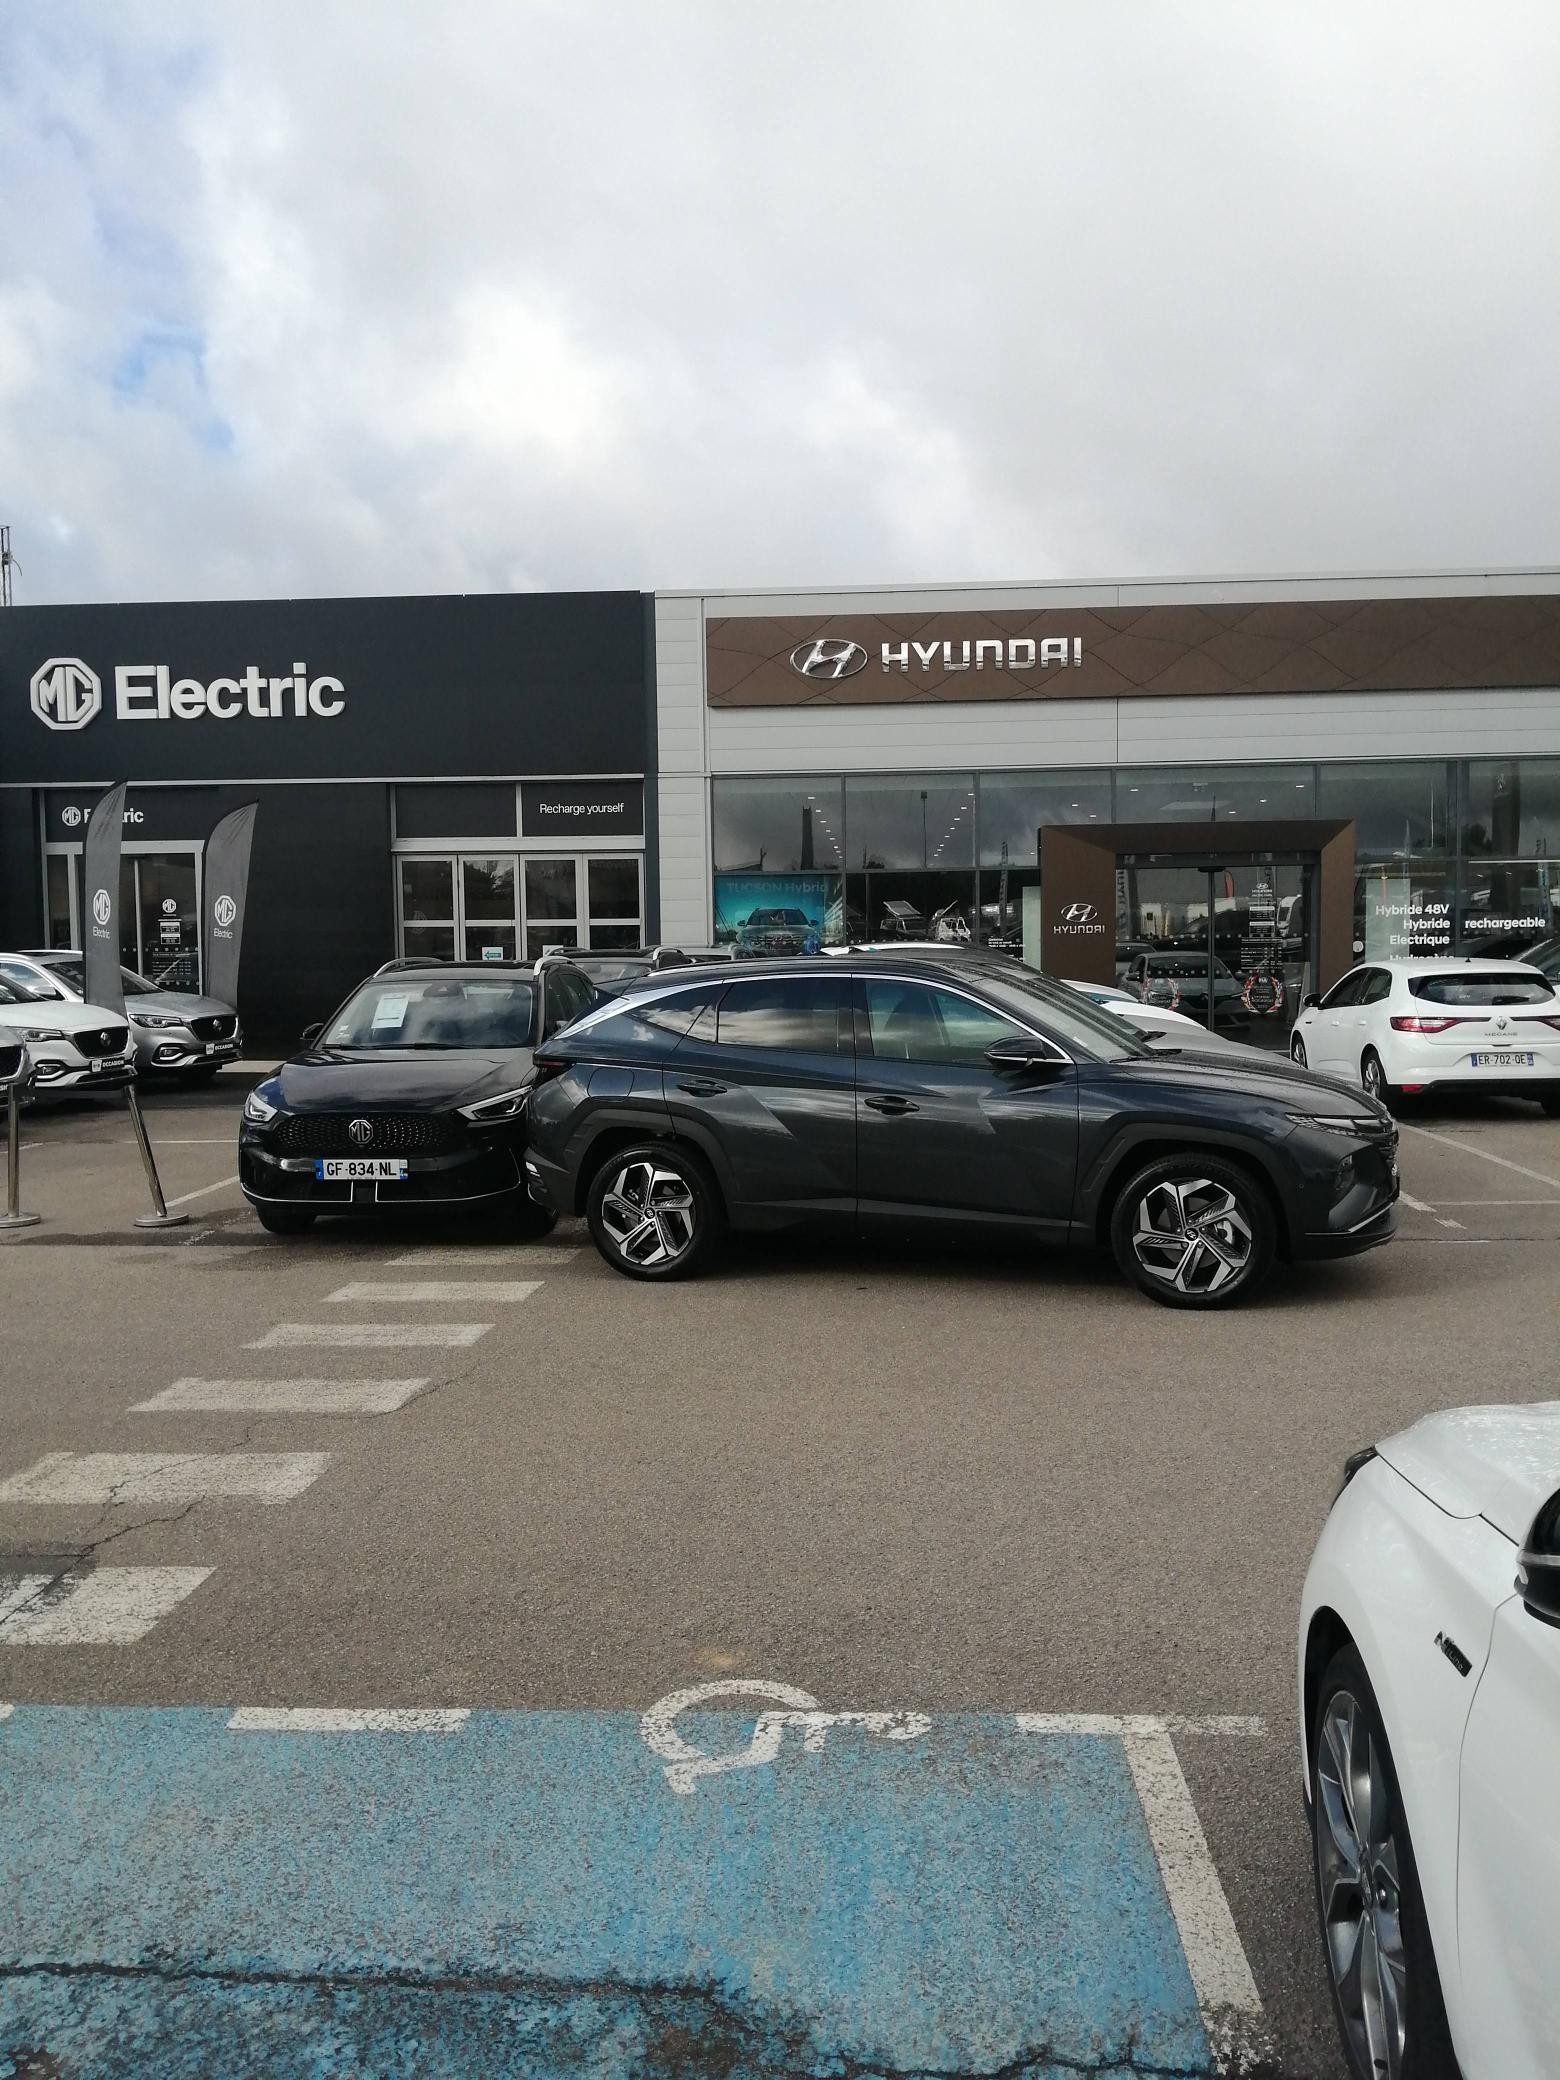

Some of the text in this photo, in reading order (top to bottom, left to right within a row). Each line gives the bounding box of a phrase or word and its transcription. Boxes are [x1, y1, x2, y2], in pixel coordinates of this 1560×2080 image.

[881, 637, 1082, 673] HYUNDAI
[36, 662, 346, 724] MG Electric
[539, 802, 625, 816] Recharge yourself
[63, 808, 80, 825] MG
[726, 881, 782, 893] TUCSON
[95, 891, 110, 923] MG
[163, 899, 176, 913] MG
[216, 897, 235, 924] MG
[1375, 904, 1450, 918] Hybride 48V
[1053, 925, 1105, 934] HYUNDAI
[1403, 917, 1546, 931] Hybride rechargeable
[92, 926, 111, 939] Electric
[213, 927, 233, 939] Electric
[1389, 935, 1450, 946] Electrique
[350, 1121, 372, 1142] MG
[326, 1162, 397, 1176] GF-834-NL
